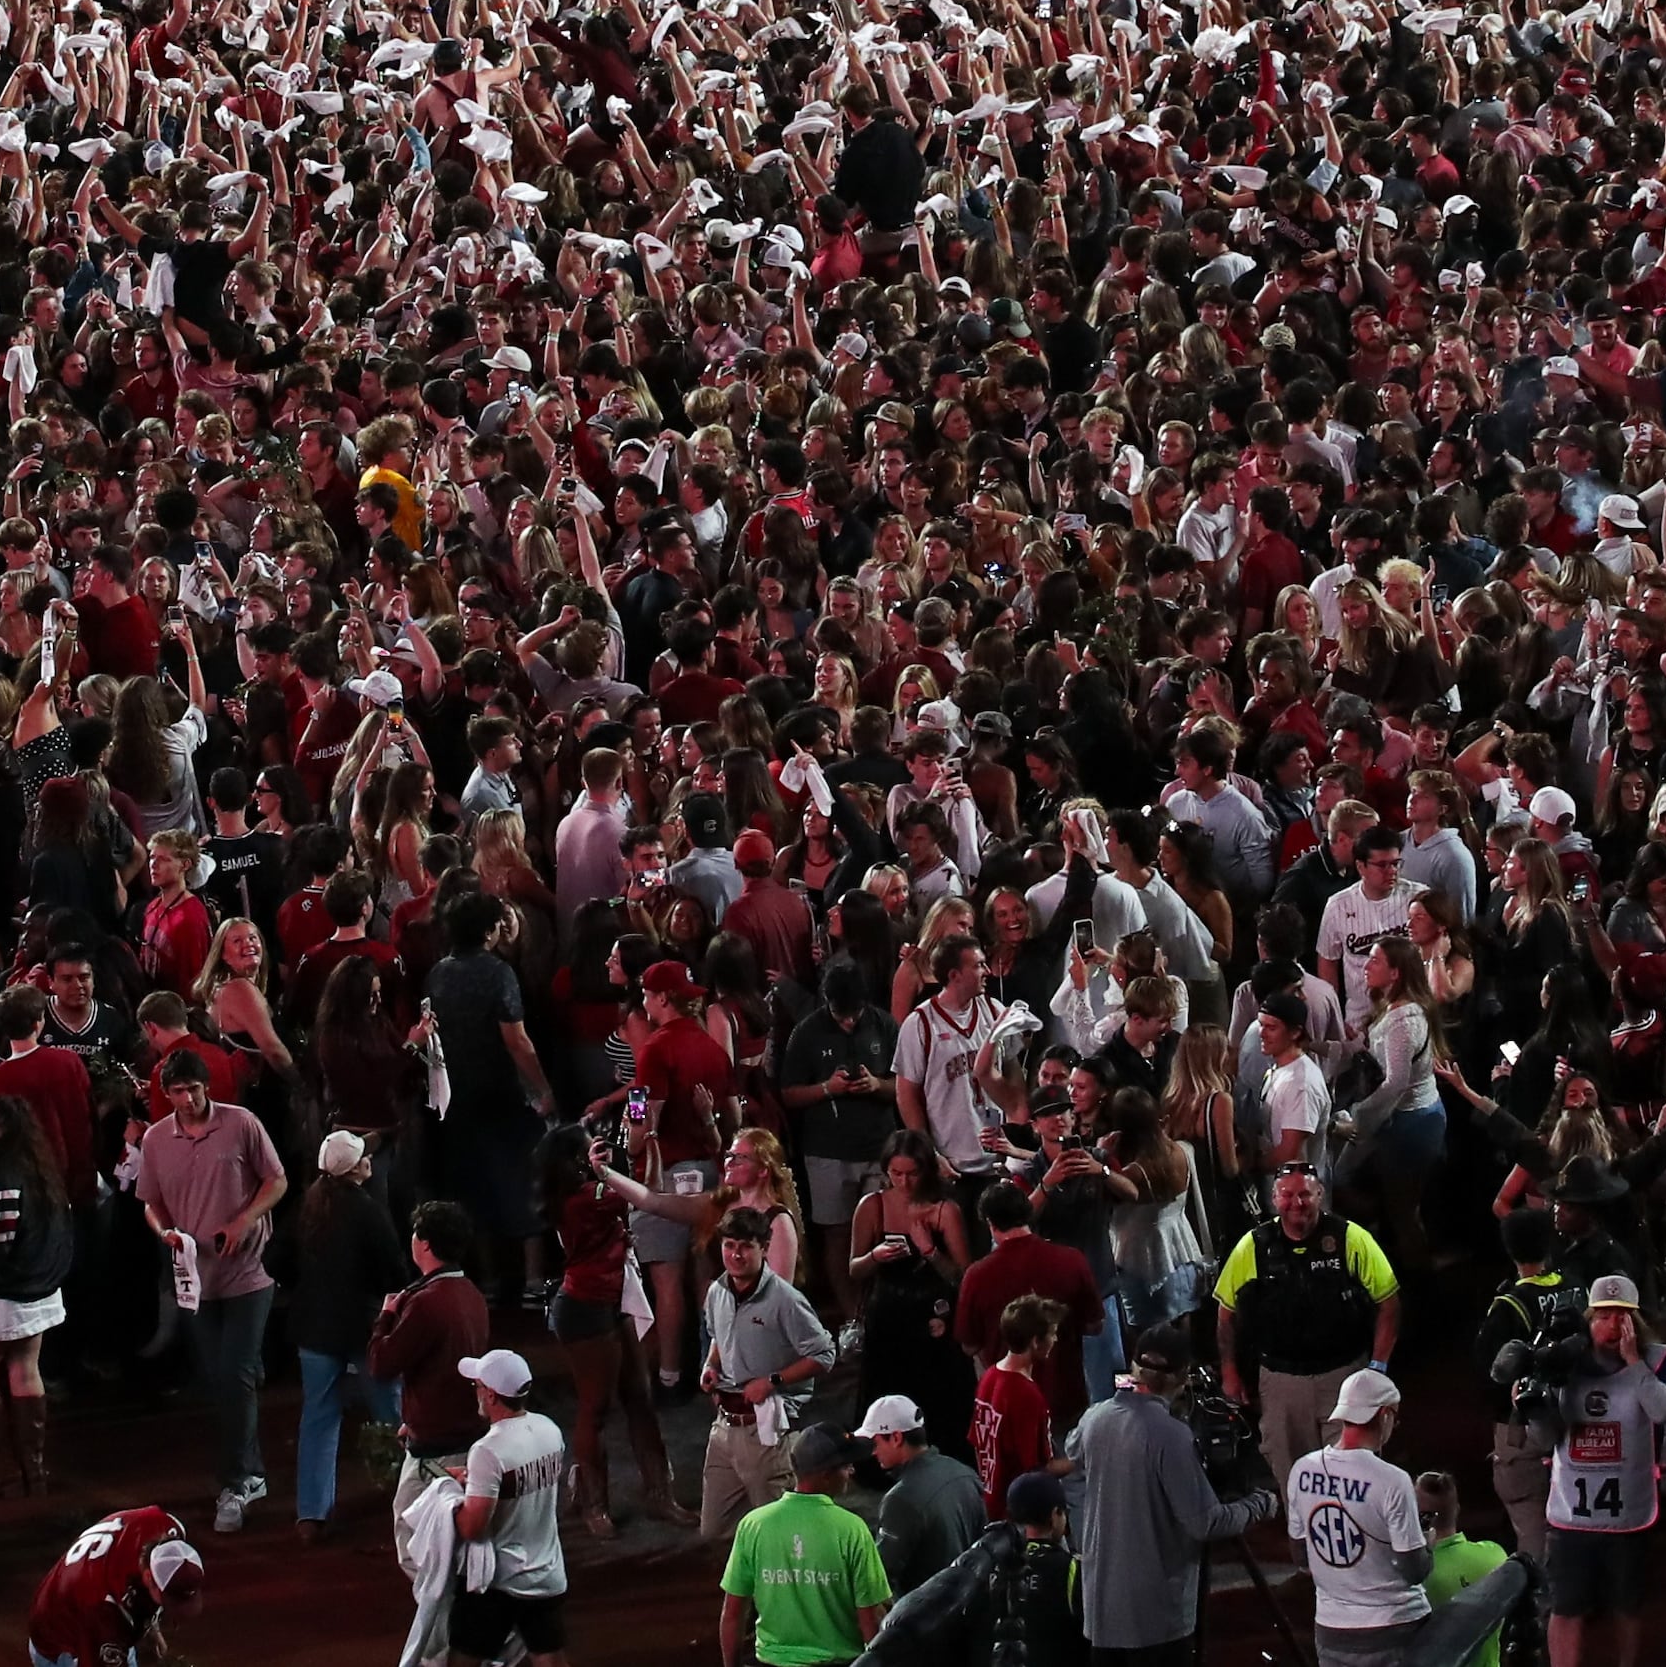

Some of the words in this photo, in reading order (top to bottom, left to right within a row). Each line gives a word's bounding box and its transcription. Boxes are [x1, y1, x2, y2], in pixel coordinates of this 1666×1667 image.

[221, 853, 261, 872] SAMUEL
[1311, 1257, 1341, 1272] POLICE
[1576, 1437, 1615, 1448] BUREAU
[1298, 1471, 1371, 1504] CREW
[1572, 1477, 1624, 1518] 14
[65, 1521, 123, 1567] 16
[1312, 1513, 1364, 1566] SEC
[762, 1568, 800, 1584] EVENT
